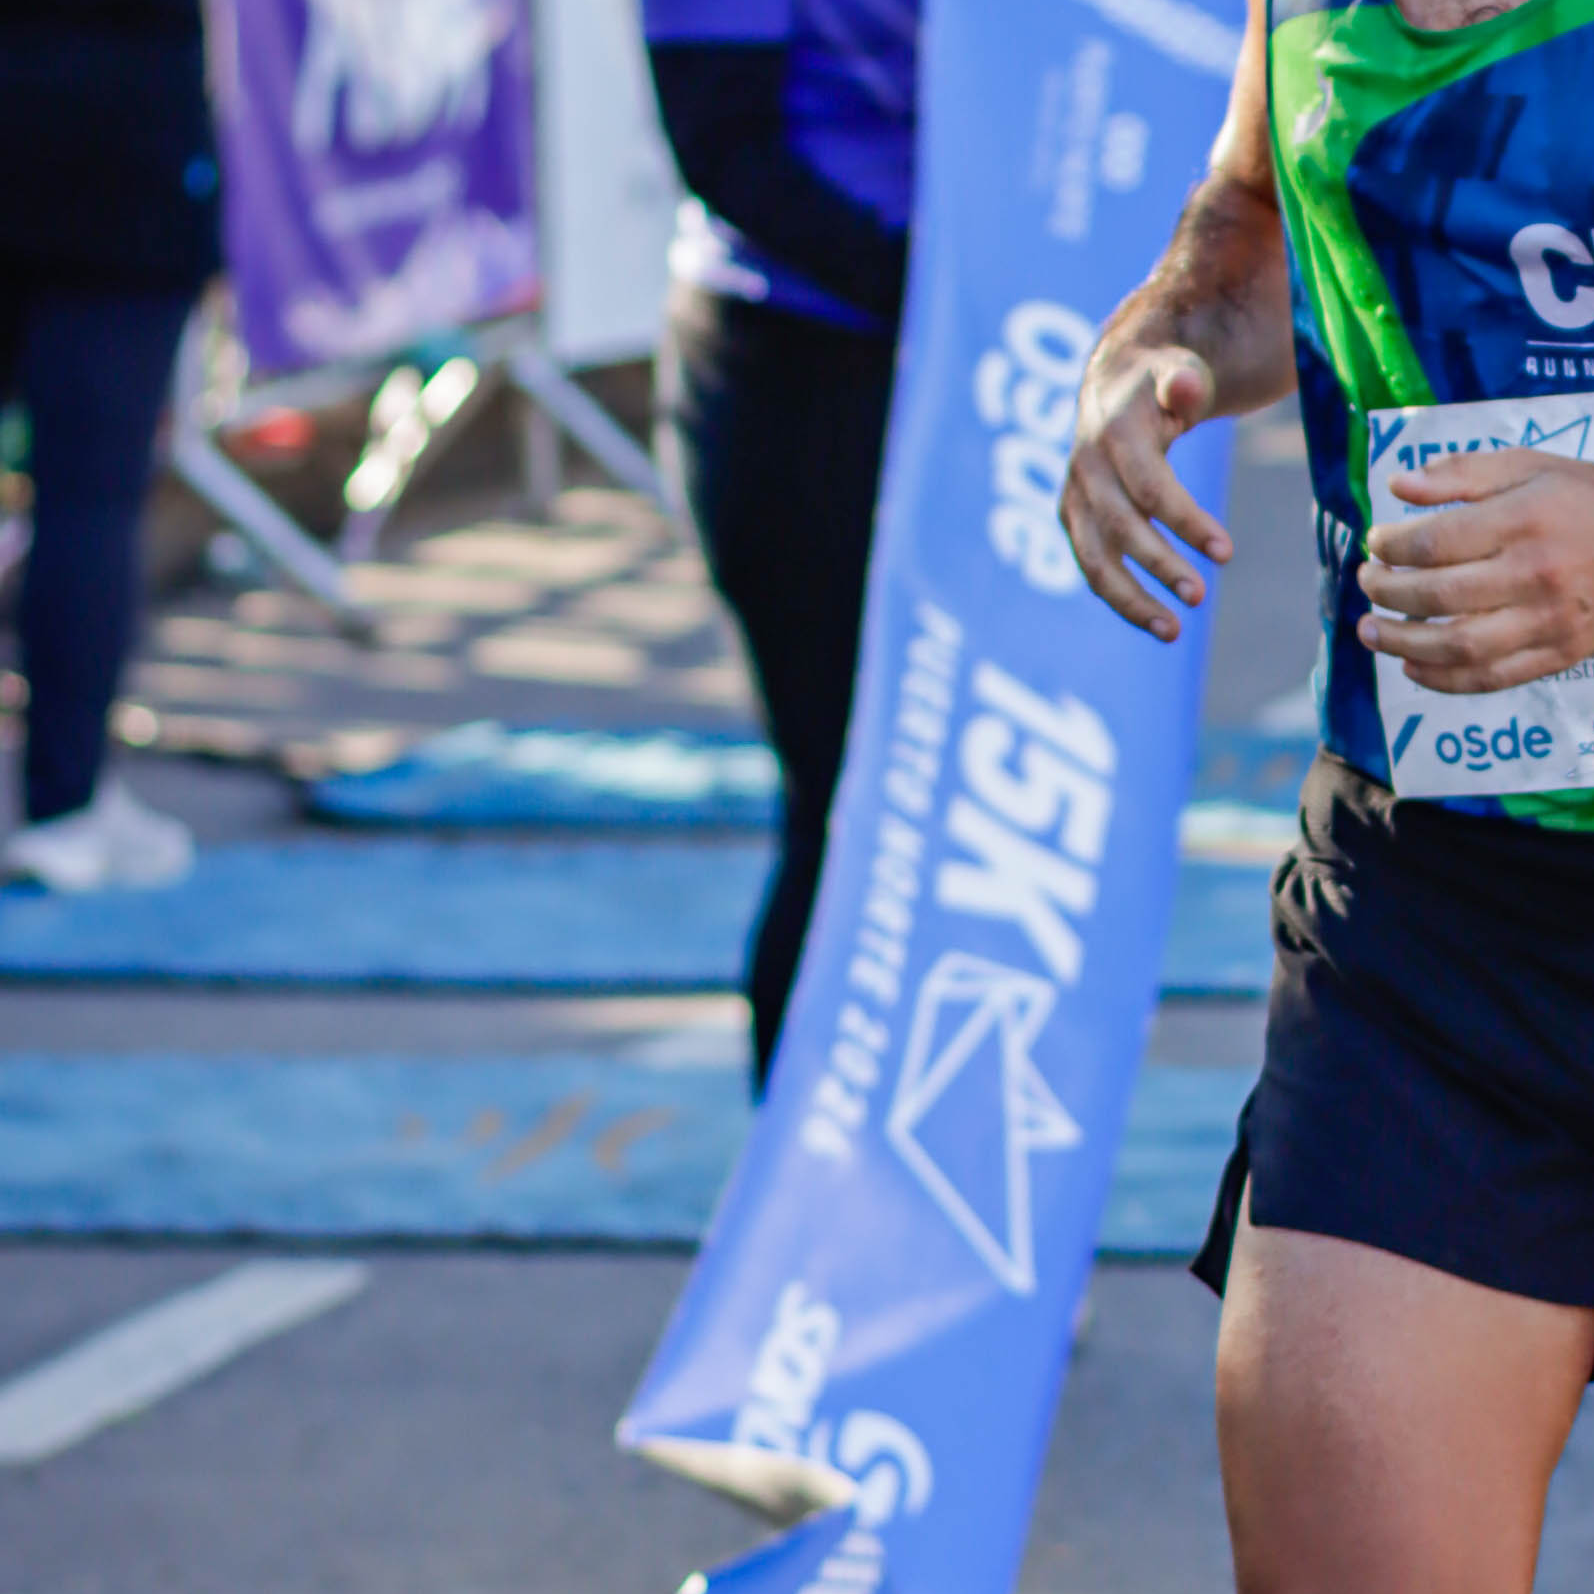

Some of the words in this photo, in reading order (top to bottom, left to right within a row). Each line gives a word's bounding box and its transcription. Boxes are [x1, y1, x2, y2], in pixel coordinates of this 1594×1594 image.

[887, 599, 963, 817] PUERTO
[1435, 716, 1553, 772] osde
[848, 814, 925, 1008] NORTE
[936, 659, 1119, 985] 15K
